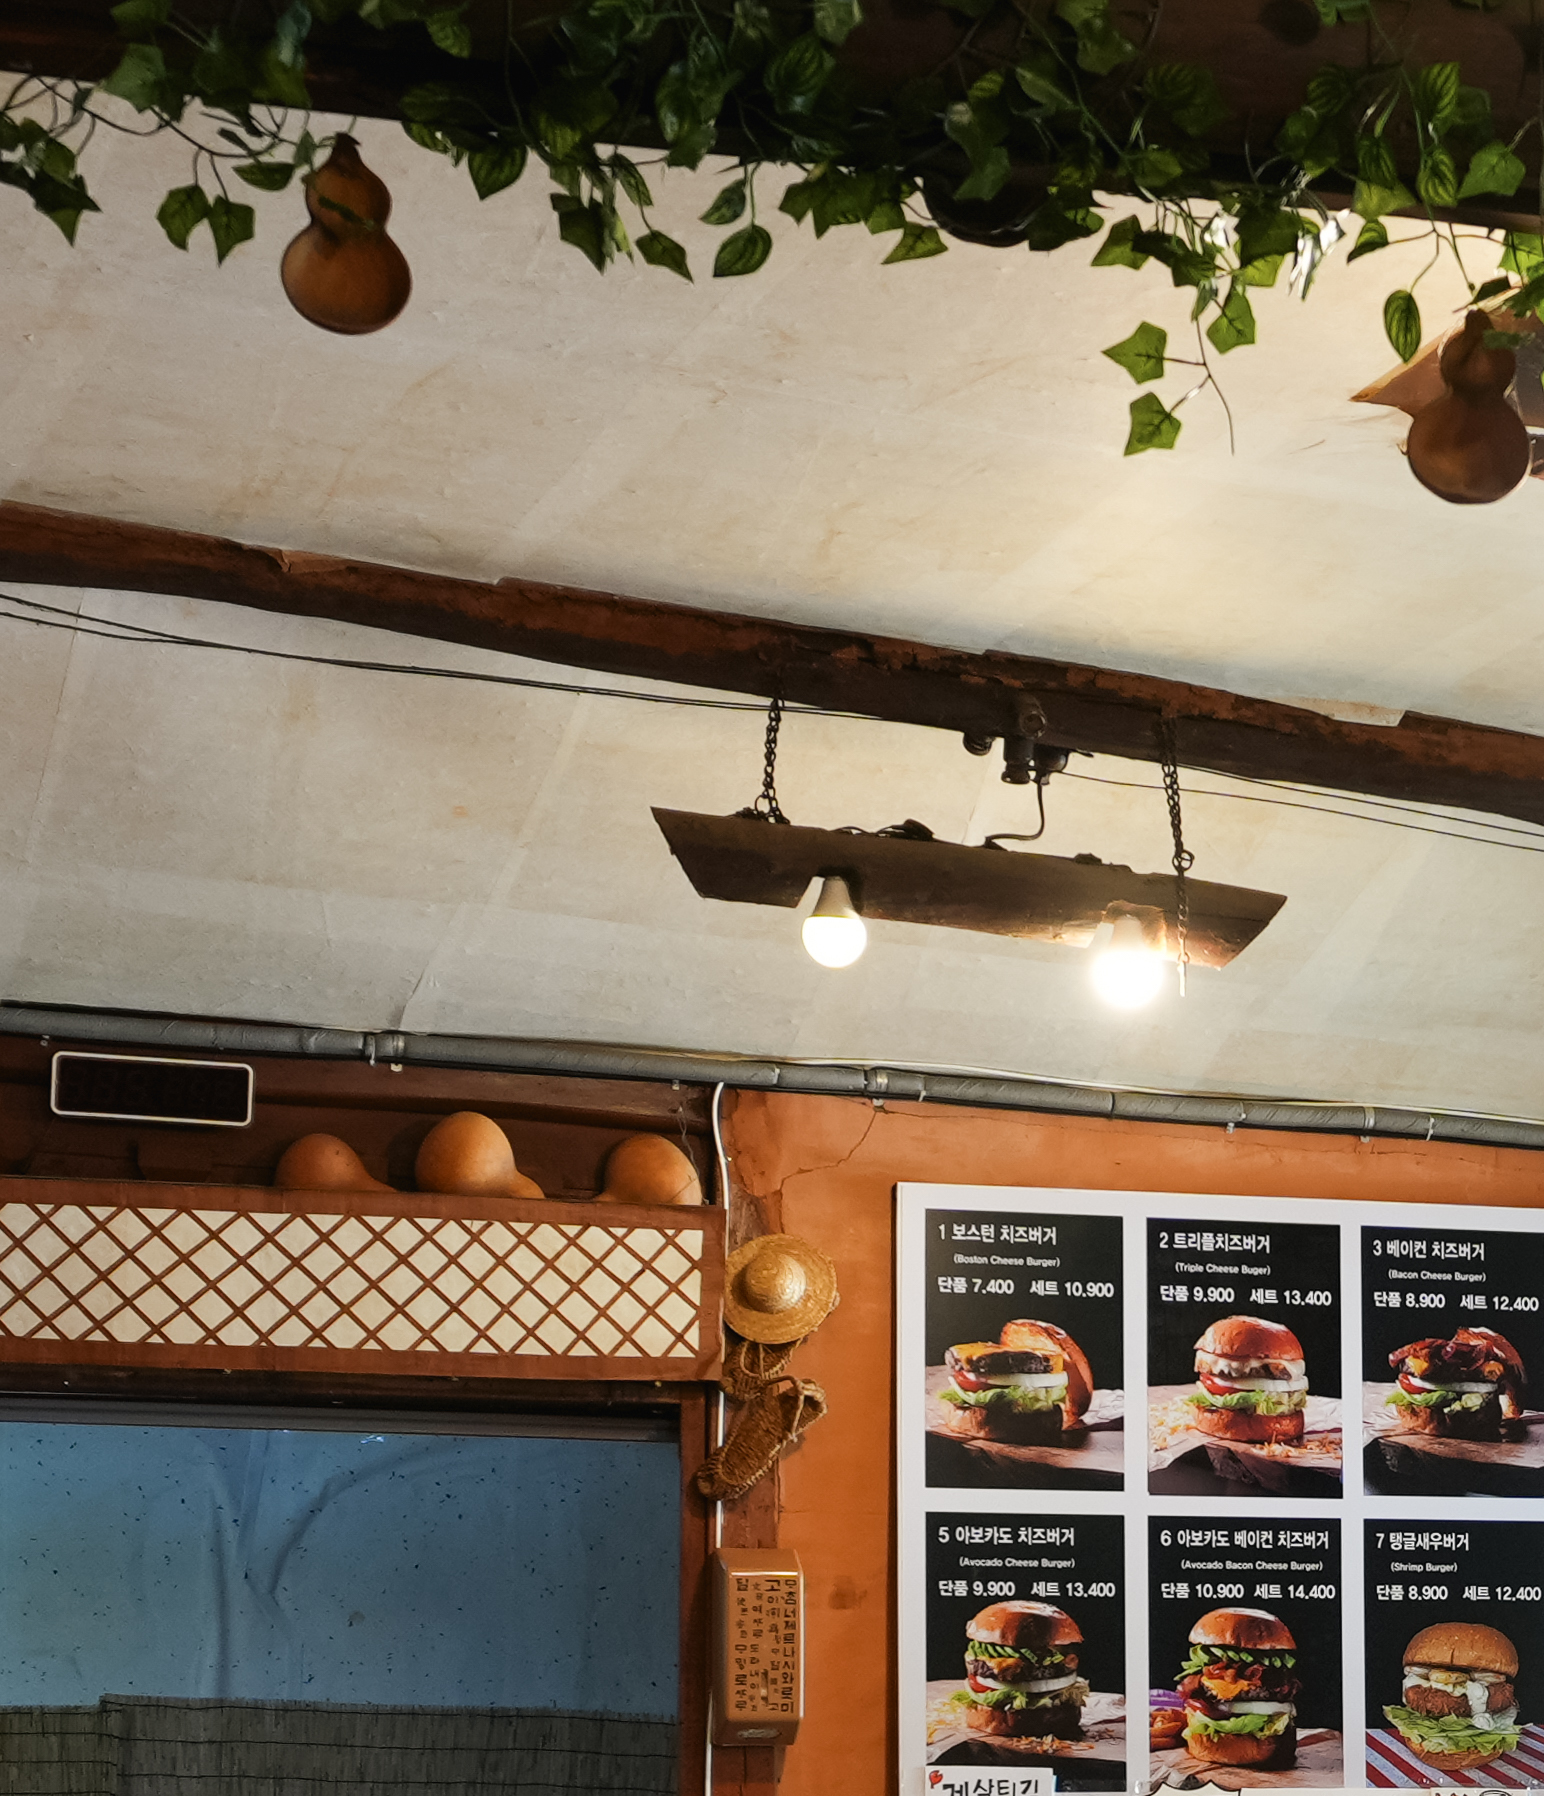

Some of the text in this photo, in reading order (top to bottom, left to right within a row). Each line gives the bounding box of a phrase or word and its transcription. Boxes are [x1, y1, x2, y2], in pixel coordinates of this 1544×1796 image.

[939, 1224, 1056, 1245] 1 보스턴 치즈버거
[1160, 1232, 1269, 1253] 2 트리플치즈버거
[1373, 1240, 1484, 1260] 3 베이컨 치즈버거
[954, 1254, 1060, 1267] (Boston Cheese Burger)
[1175, 1262, 1270, 1275] (Triple Cheese Buger)
[1389, 1269, 1486, 1282] (Bacon Cheese Burger)
[938, 1277, 1114, 1297] 단품 7.400 세트 10.900
[1160, 1285, 1331, 1306] 단품 9.900 세트 13.400
[1374, 1292, 1539, 1311] 단품 8.900 세트 12.400
[939, 1526, 1074, 1546] 5 아보카도 치즈버거
[1161, 1529, 1328, 1549] 6 아보카도 베이컨 치즈버거
[1376, 1532, 1469, 1550] 7 탱글새우버거
[960, 1557, 1075, 1568] (Avocado Cheese Burger)
[1181, 1560, 1323, 1571] (Avocado Bacon Cheese Burger)
[1391, 1562, 1457, 1572] (Shrimp Burger)
[939, 1580, 1115, 1597] 단품 9.900 세트 13.400
[1161, 1583, 1335, 1599] 단품 10.900 세트 14.400
[1377, 1585, 1541, 1601] 단품 8.900 세트 12.400
